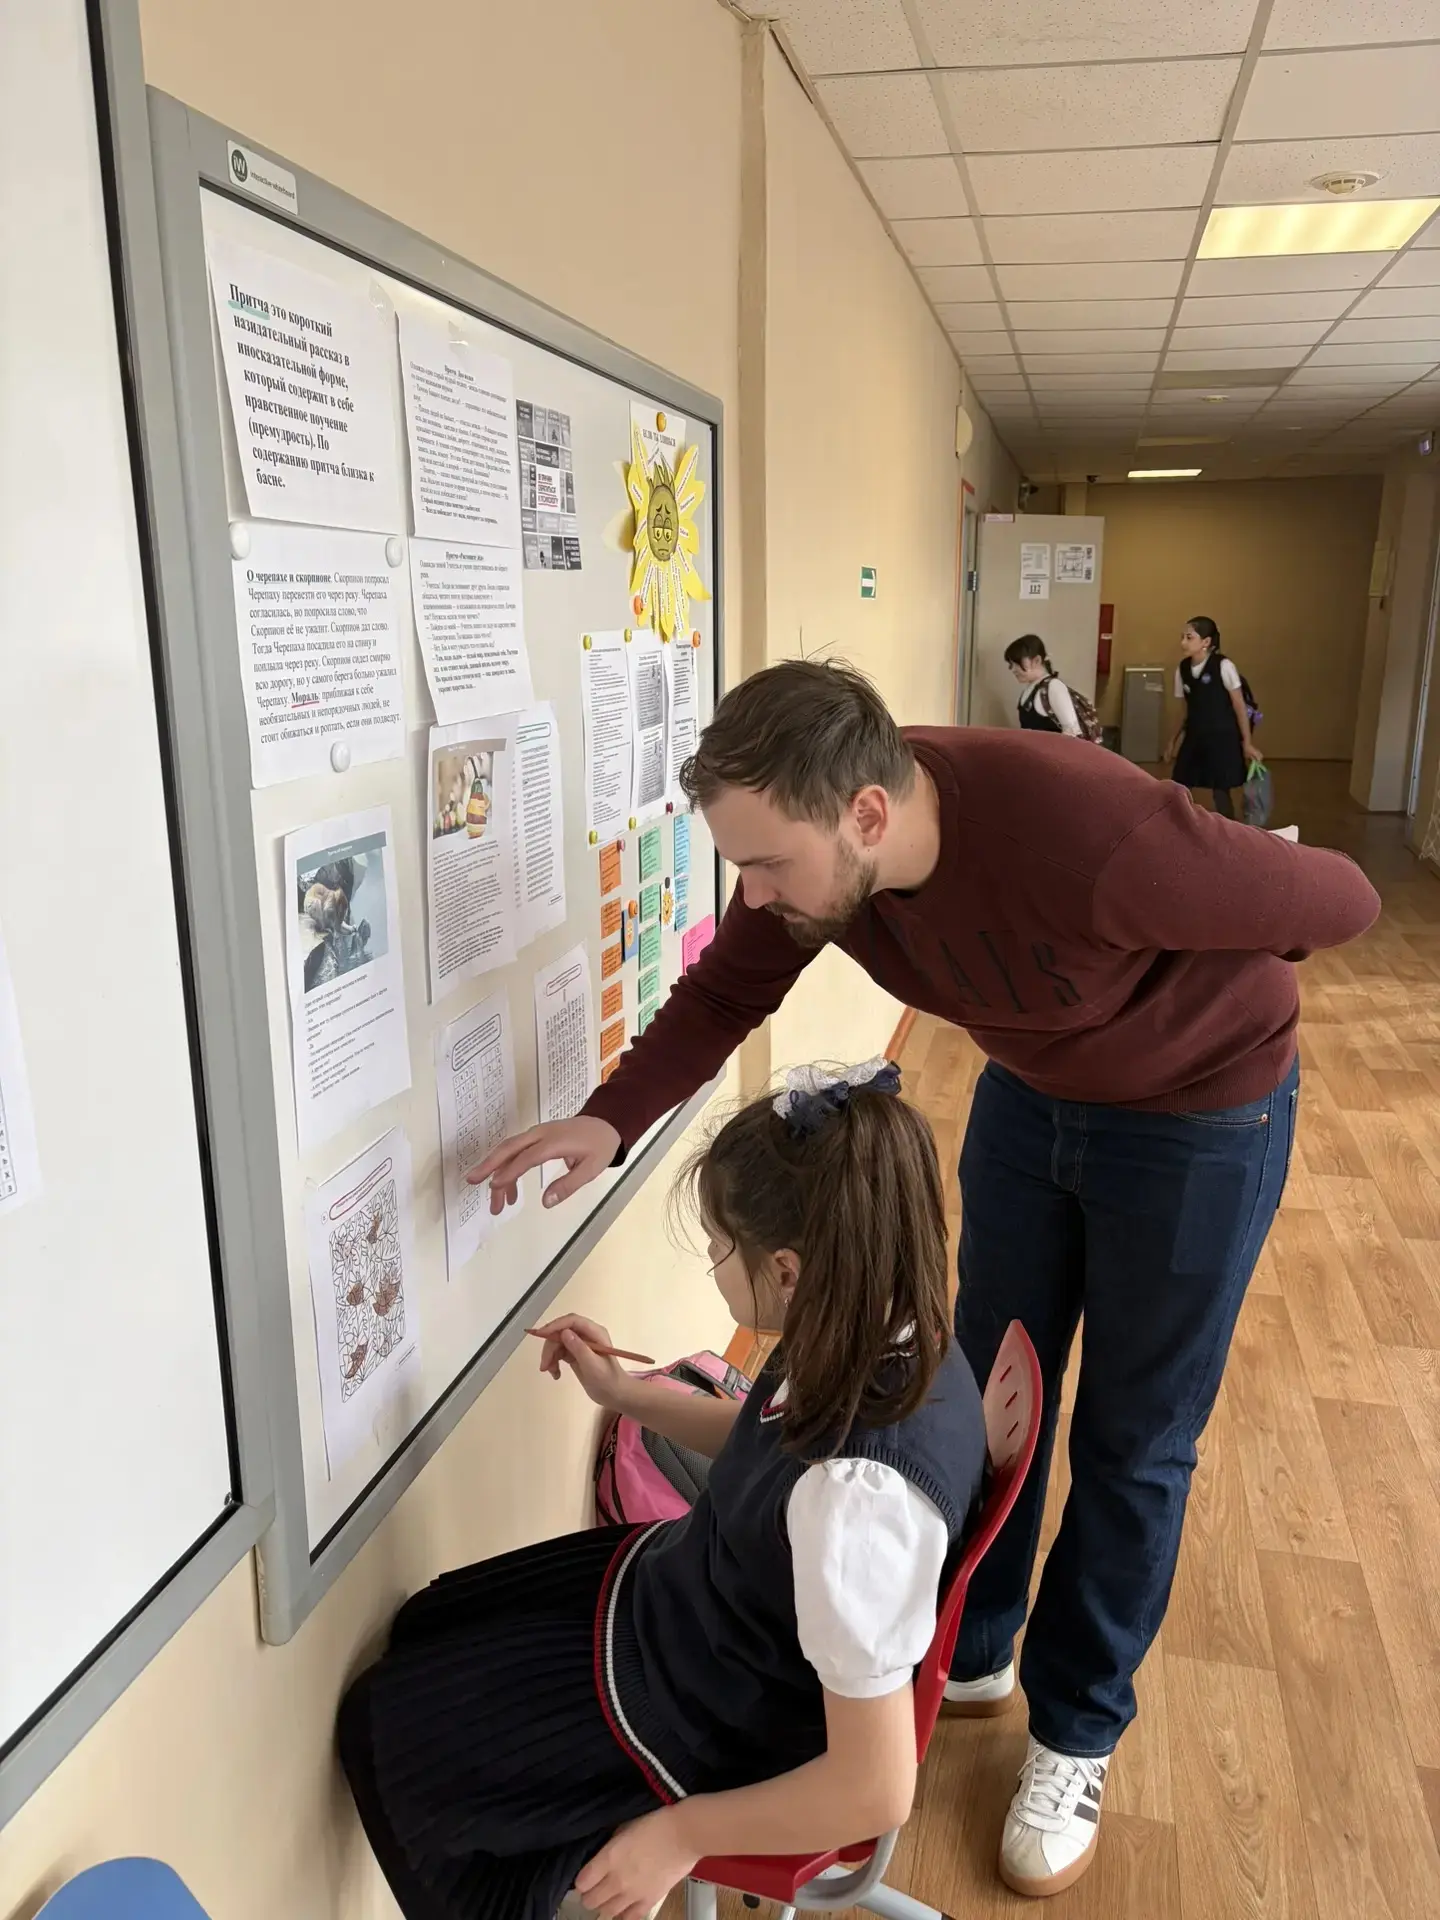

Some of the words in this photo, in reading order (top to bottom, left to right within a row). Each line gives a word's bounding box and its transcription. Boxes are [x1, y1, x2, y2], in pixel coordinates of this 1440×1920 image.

[229, 283, 270, 314] Притча
[271, 304, 286, 320] это
[289, 312, 332, 337] короткий
[234, 315, 308, 352] назидательный
[309, 343, 343, 364] рассказ
[345, 355, 350, 366] в
[237, 342, 317, 379] иносказательной
[319, 366, 348, 390] форме,
[244, 369, 287, 392] который
[288, 383, 328, 405] содержит
[330, 396, 336, 407] в
[337, 397, 354, 412] себе
[245, 394, 308, 422] нравственное
[310, 413, 348, 432] поучение
[248, 416, 316, 451] (премудрость).
[317, 434, 330, 450] По
[253, 446, 308, 469] содержанию
[310, 460, 340, 475] притча
[341, 462, 368, 480] близка
[369, 472, 374, 482] к
[256, 468, 286, 488] басне.
[247, 569, 254, 581] О
[256, 573, 287, 584] черепахе
[289, 574, 293, 582] и
[334, 572, 363, 586] Скорпион
[365, 576, 389, 586] попросил
[248, 588, 280, 603] Черепаху
[282, 591, 314, 603] перевезти
[316, 592, 326, 600] его
[328, 592, 344, 603] через
[345, 592, 360, 602] реку.
[362, 589, 387, 602] Черепаха
[250, 609, 293, 619] согласилась,
[304, 608, 336, 619] попросила
[251, 624, 285, 639] Скорпион
[286, 624, 294, 634] её
[296, 626, 303, 634] не
[305, 625, 329, 636] ужалит.
[331, 621, 360, 635] Скорпион
[361, 624, 370, 632] дал
[252, 642, 272, 654] Тогда
[274, 642, 305, 656] Черепаха
[307, 641, 335, 650] посадила
[355, 639, 371, 650] спину
[254, 662, 283, 672] поплыла
[285, 660, 303, 672] через
[304, 659, 321, 671] реку.
[322, 656, 351, 668] Скорпион
[352, 655, 368, 664] сидел
[370, 654, 390, 664] смирно
[255, 681, 268, 690] всю
[270, 678, 295, 691] дорогу,
[296, 677, 305, 686] но
[306, 676, 310, 687] у
[312, 674, 333, 684] самого
[334, 671, 353, 684] берега
[354, 669, 375, 679] больно
[376, 668, 397, 680] ужалил
[291, 692, 320, 705] Мораль:
[322, 687, 354, 702] приближая
[361, 684, 374, 694] себе
[259, 710, 310, 726] необязательных
[317, 704, 360, 718] непорядочных
[361, 699, 381, 710] людей,
[260, 733, 279, 744] стоит
[280, 727, 313, 740] обижаться
[315, 726, 320, 734] и
[320, 723, 345, 736] роптать,
[346, 720, 359, 728] если
[361, 718, 372, 726] они
[373, 714, 401, 724] подведут.
